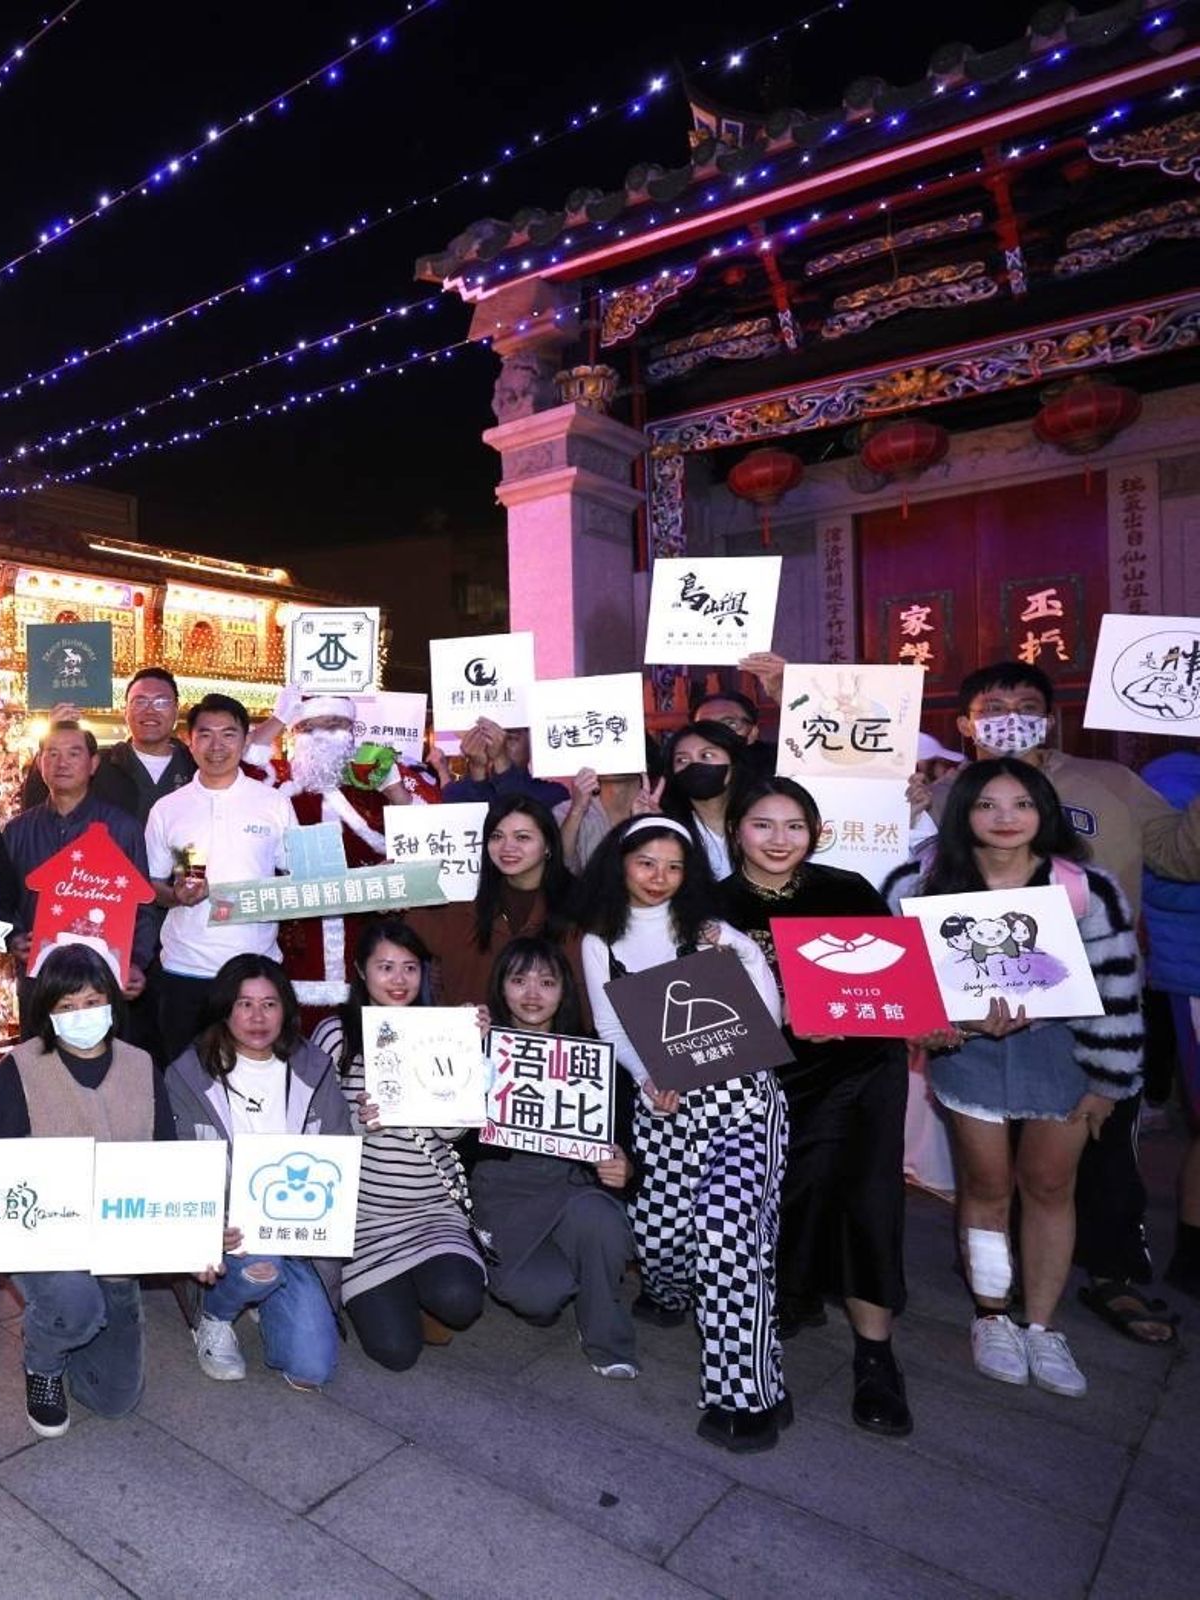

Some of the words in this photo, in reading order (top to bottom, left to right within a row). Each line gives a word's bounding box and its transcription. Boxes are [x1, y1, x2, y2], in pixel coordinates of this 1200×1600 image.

[802, 714, 894, 753] 究匠
[841, 820, 899, 845] 果然
[71, 866, 110, 890] Merry
[55, 881, 122, 902] Christmas
[238, 875, 408, 914] 金門青創新創商家
[827, 1001, 905, 1021] 夢酒館
[666, 1023, 749, 1057] FENGSHENG
[494, 1081, 604, 1137] 倫比
[259, 1226, 327, 1241] 智能輸出
